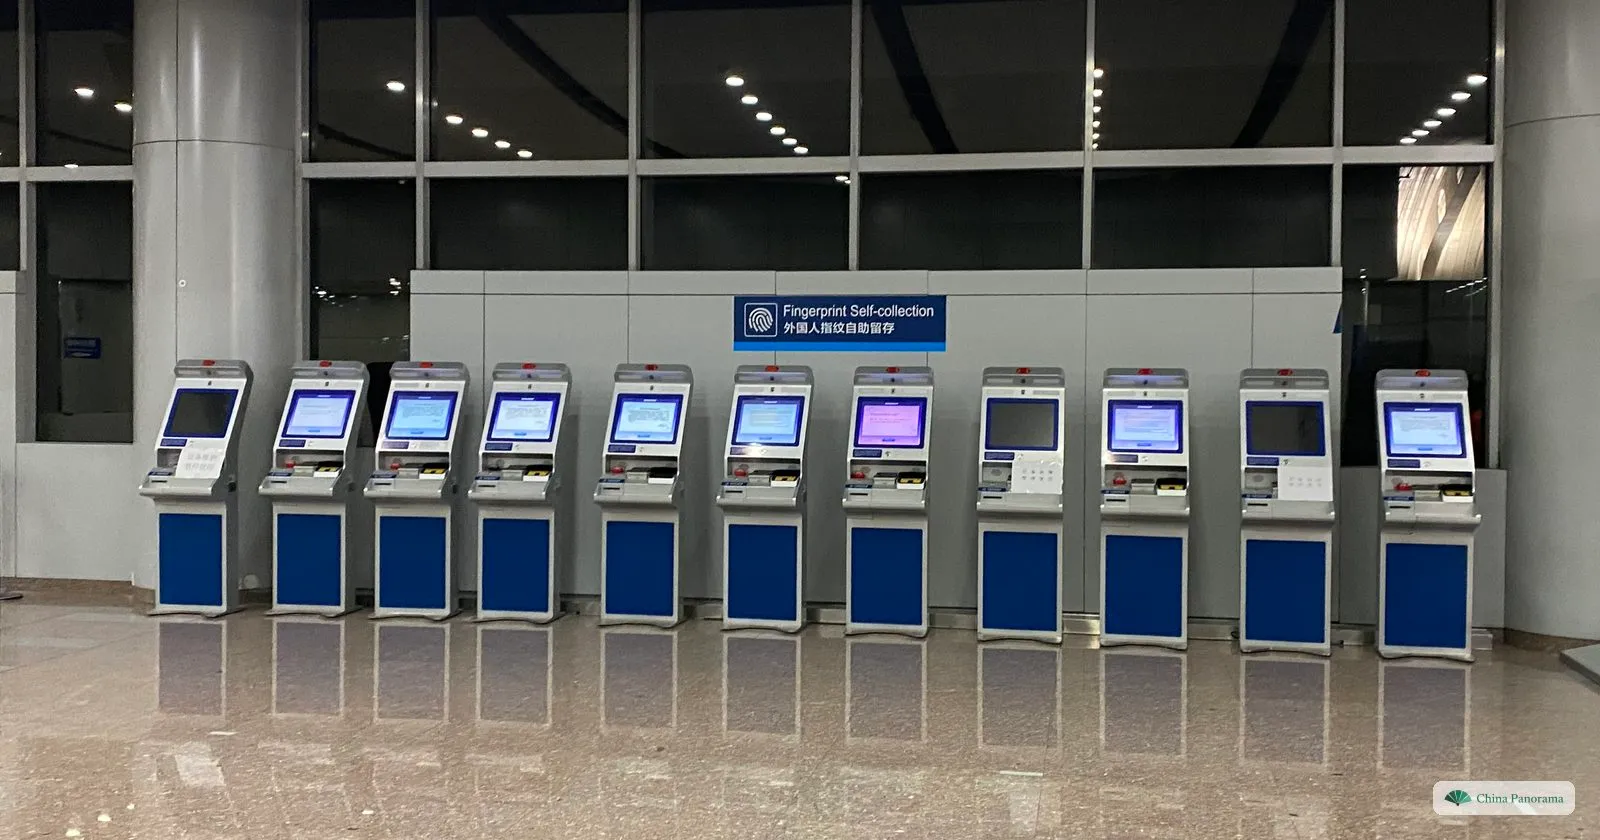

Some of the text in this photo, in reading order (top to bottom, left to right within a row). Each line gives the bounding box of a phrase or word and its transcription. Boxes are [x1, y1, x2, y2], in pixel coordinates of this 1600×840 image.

[783, 304, 934, 319] Fingerprint Self-collection
[783, 321, 895, 335] 外国人指纹自助留存
